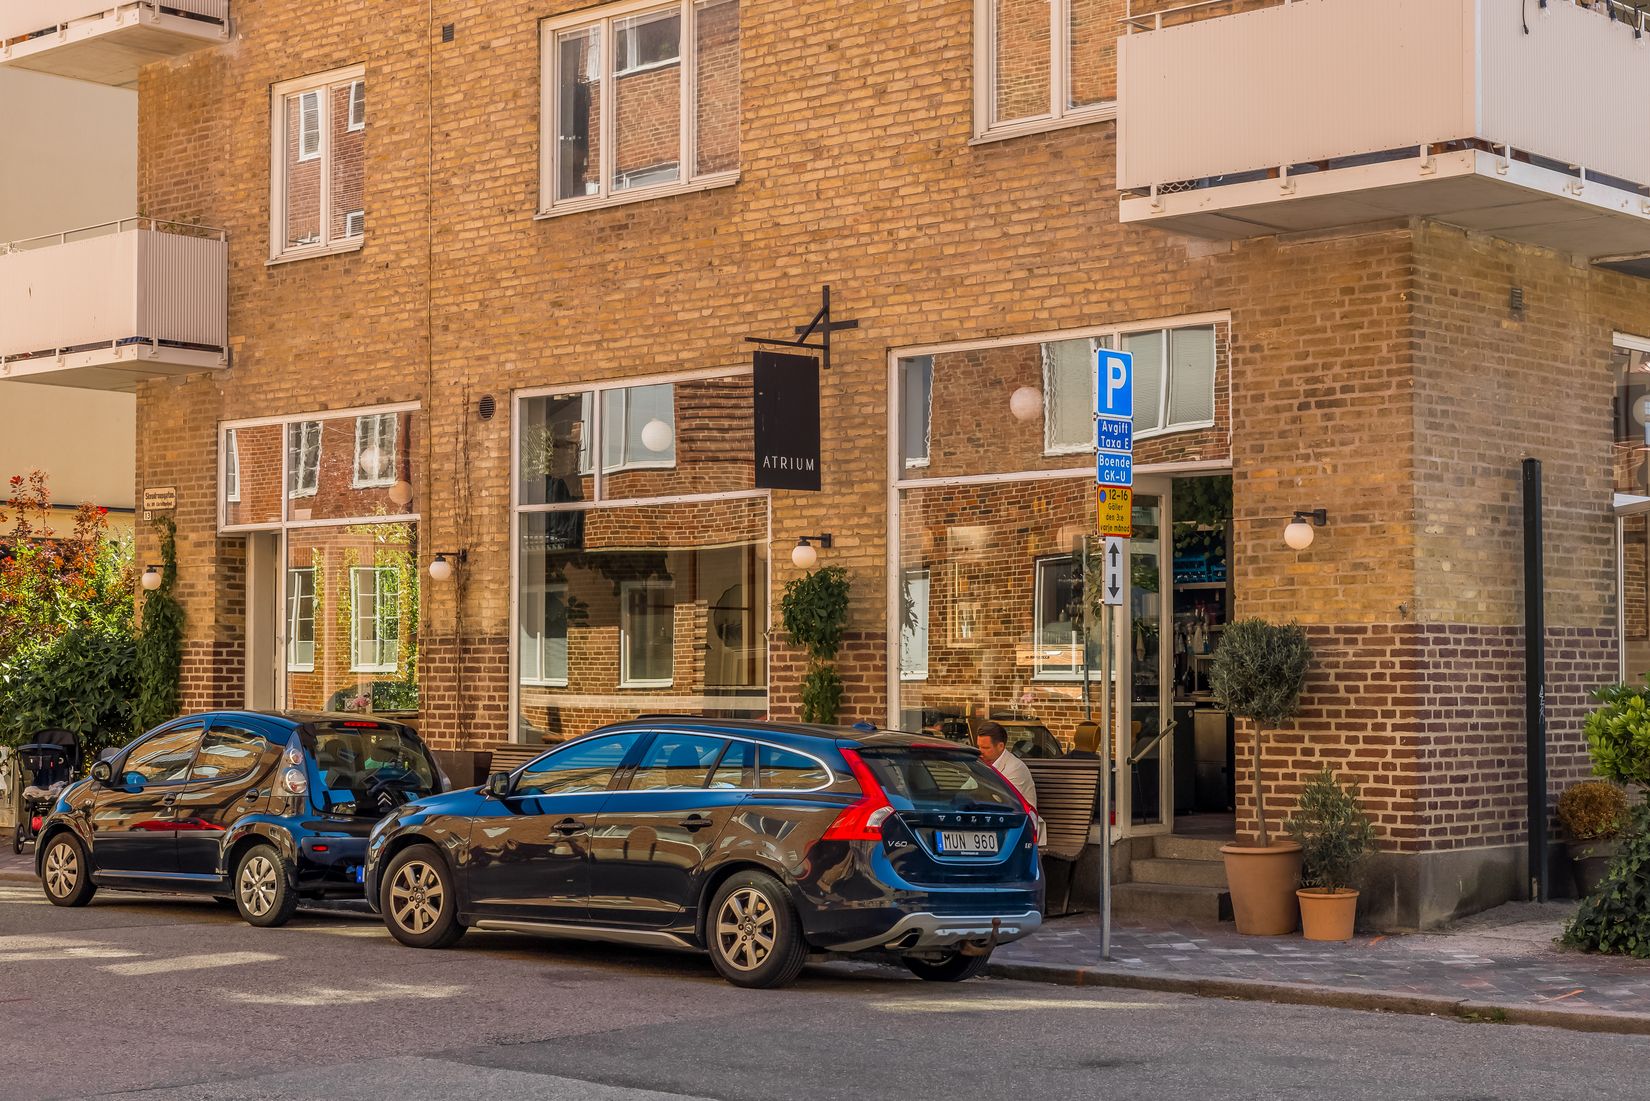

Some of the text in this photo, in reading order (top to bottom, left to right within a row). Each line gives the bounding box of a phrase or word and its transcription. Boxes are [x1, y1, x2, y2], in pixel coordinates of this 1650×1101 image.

[1106, 356, 1127, 409] P
[1101, 421, 1128, 435] Avgift
[1101, 435, 1129, 449] Taxa E
[763, 455, 814, 471] ATRIUM
[1099, 454, 1131, 468] Boende
[1104, 470, 1126, 482] GK-U
[1108, 489, 1128, 501] 12-16
[1107, 502, 1123, 511] Gäller
[1106, 513, 1115, 521] den
[1100, 524, 1130, 533] varje månad
[938, 815, 1005, 823] VOLVO
[887, 840, 908, 848] V60
[943, 833, 996, 850] MUN 960
